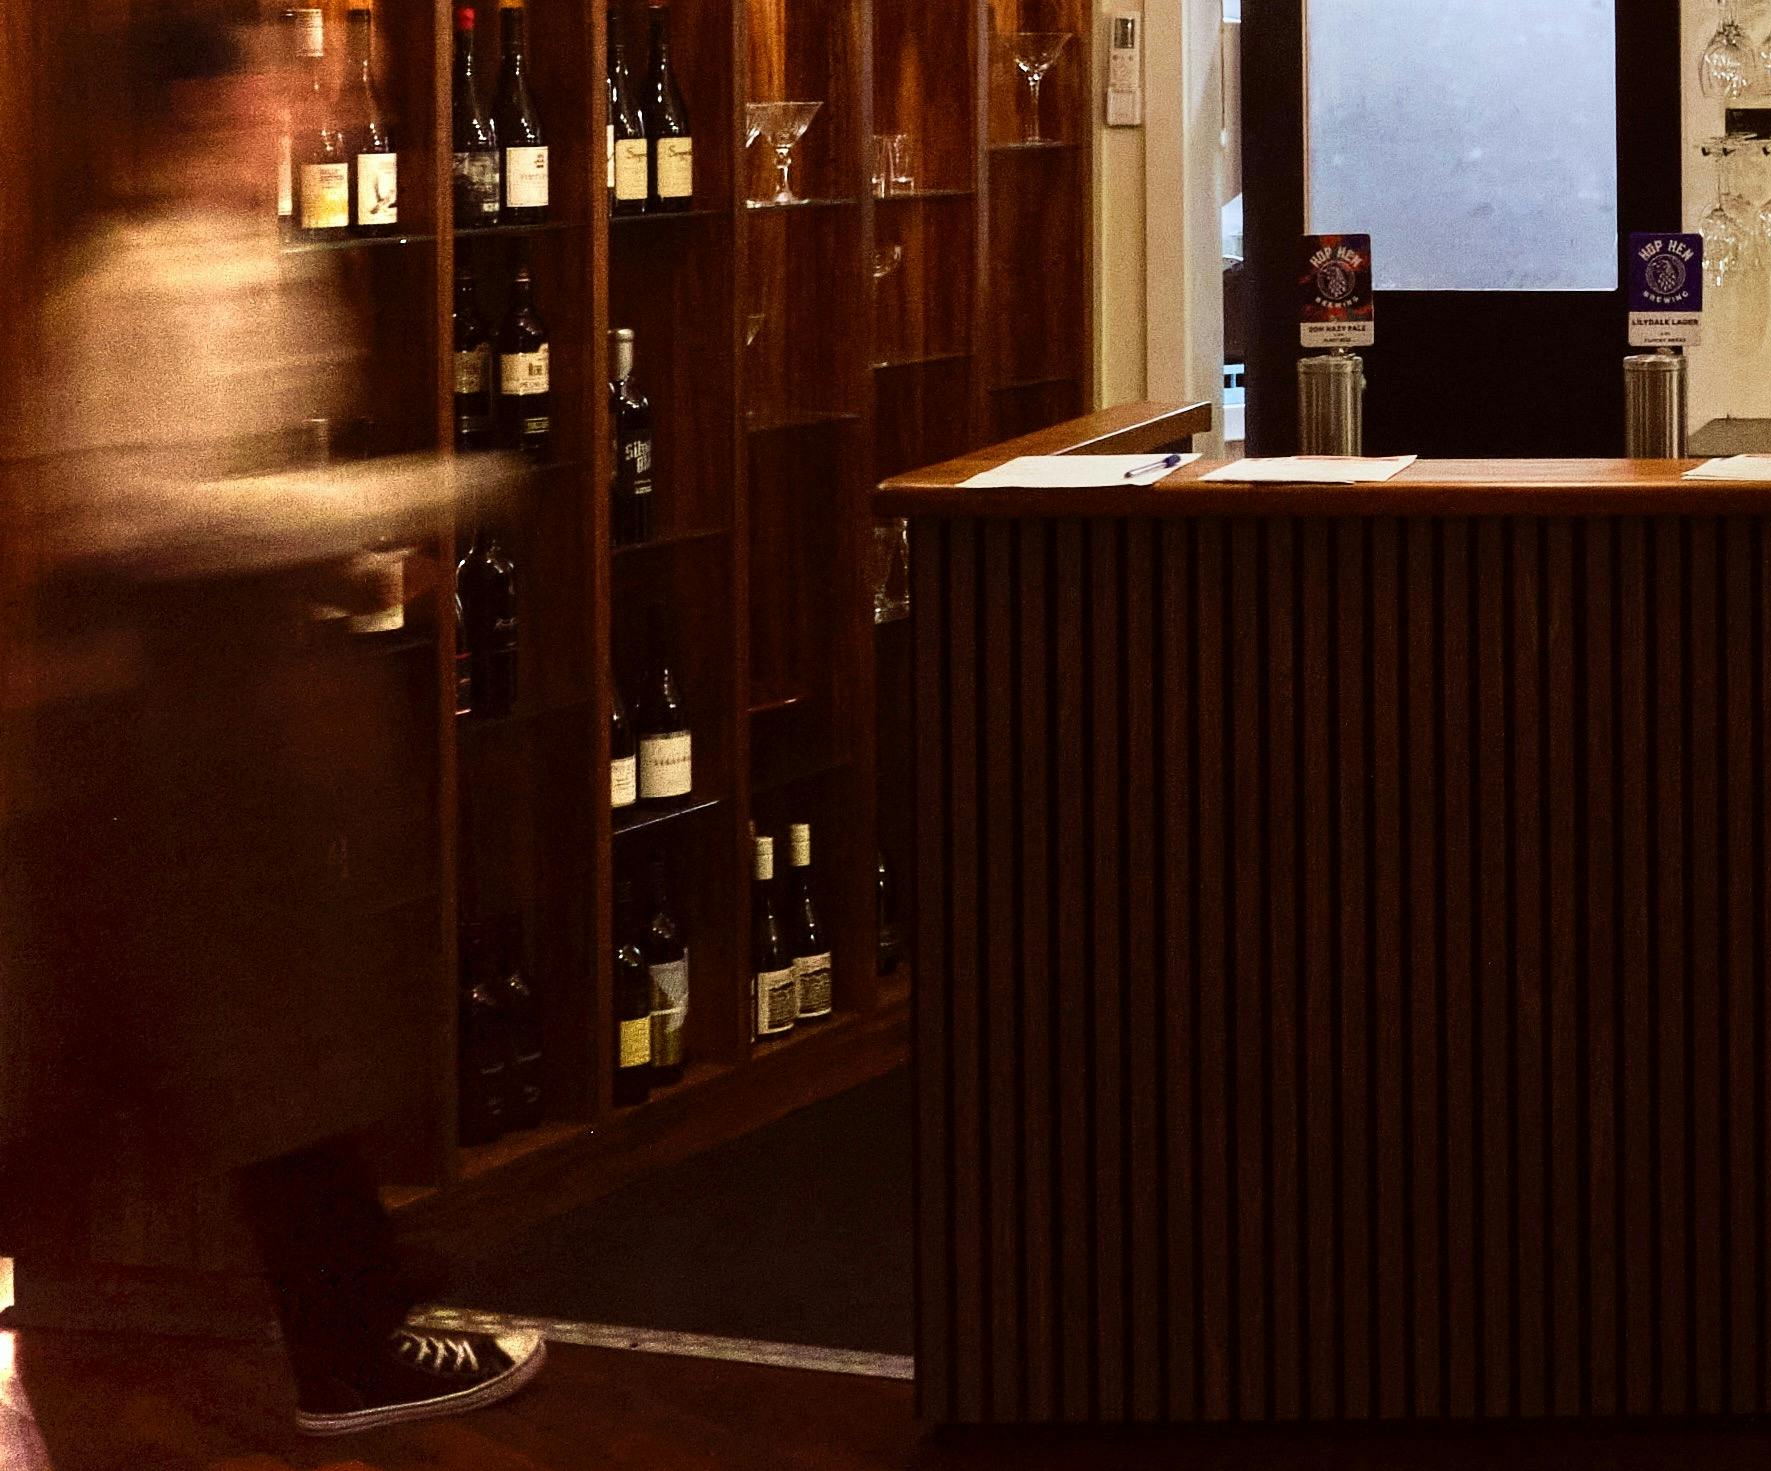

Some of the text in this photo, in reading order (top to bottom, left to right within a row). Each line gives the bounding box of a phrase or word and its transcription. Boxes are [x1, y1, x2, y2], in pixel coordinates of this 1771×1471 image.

[1309, 247, 1333, 268] HOP
[1638, 239, 1695, 262] HOP HEN
[1642, 290, 1689, 304] BREWING
